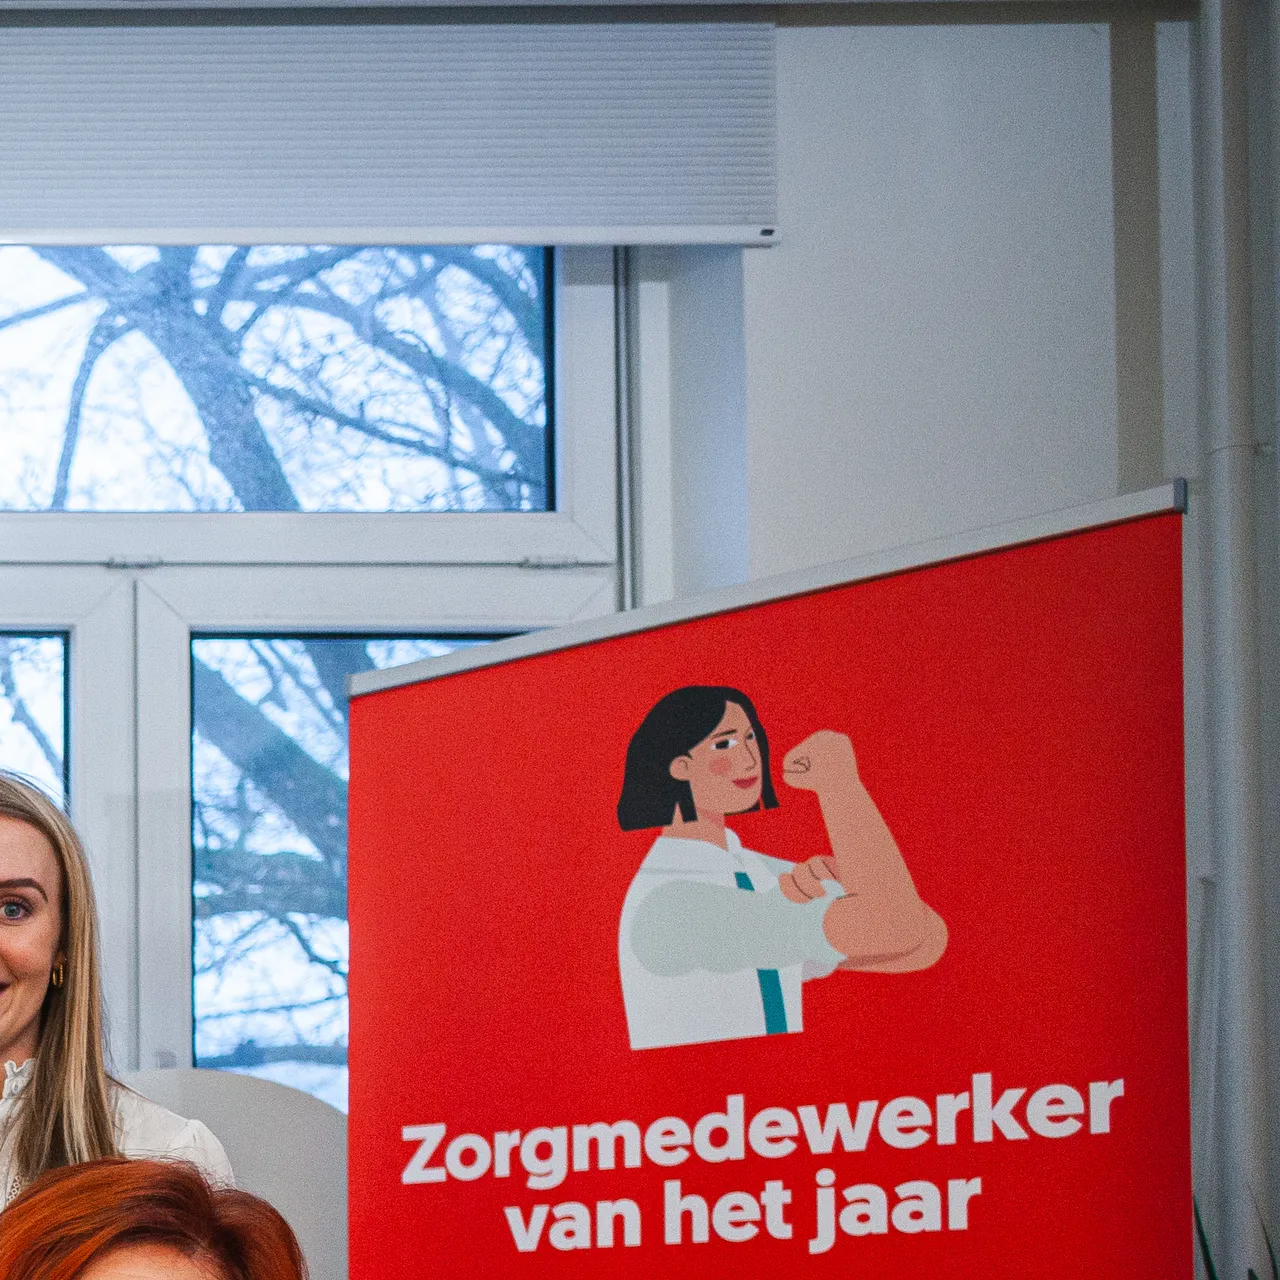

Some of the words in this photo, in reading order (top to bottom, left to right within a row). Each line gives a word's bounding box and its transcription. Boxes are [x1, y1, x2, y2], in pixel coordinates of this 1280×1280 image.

[400, 1072, 1125, 1191] Zorgmedewerker
[503, 1198, 642, 1252] van
[663, 1179, 793, 1245] het
[808, 1168, 982, 1255] jaar
